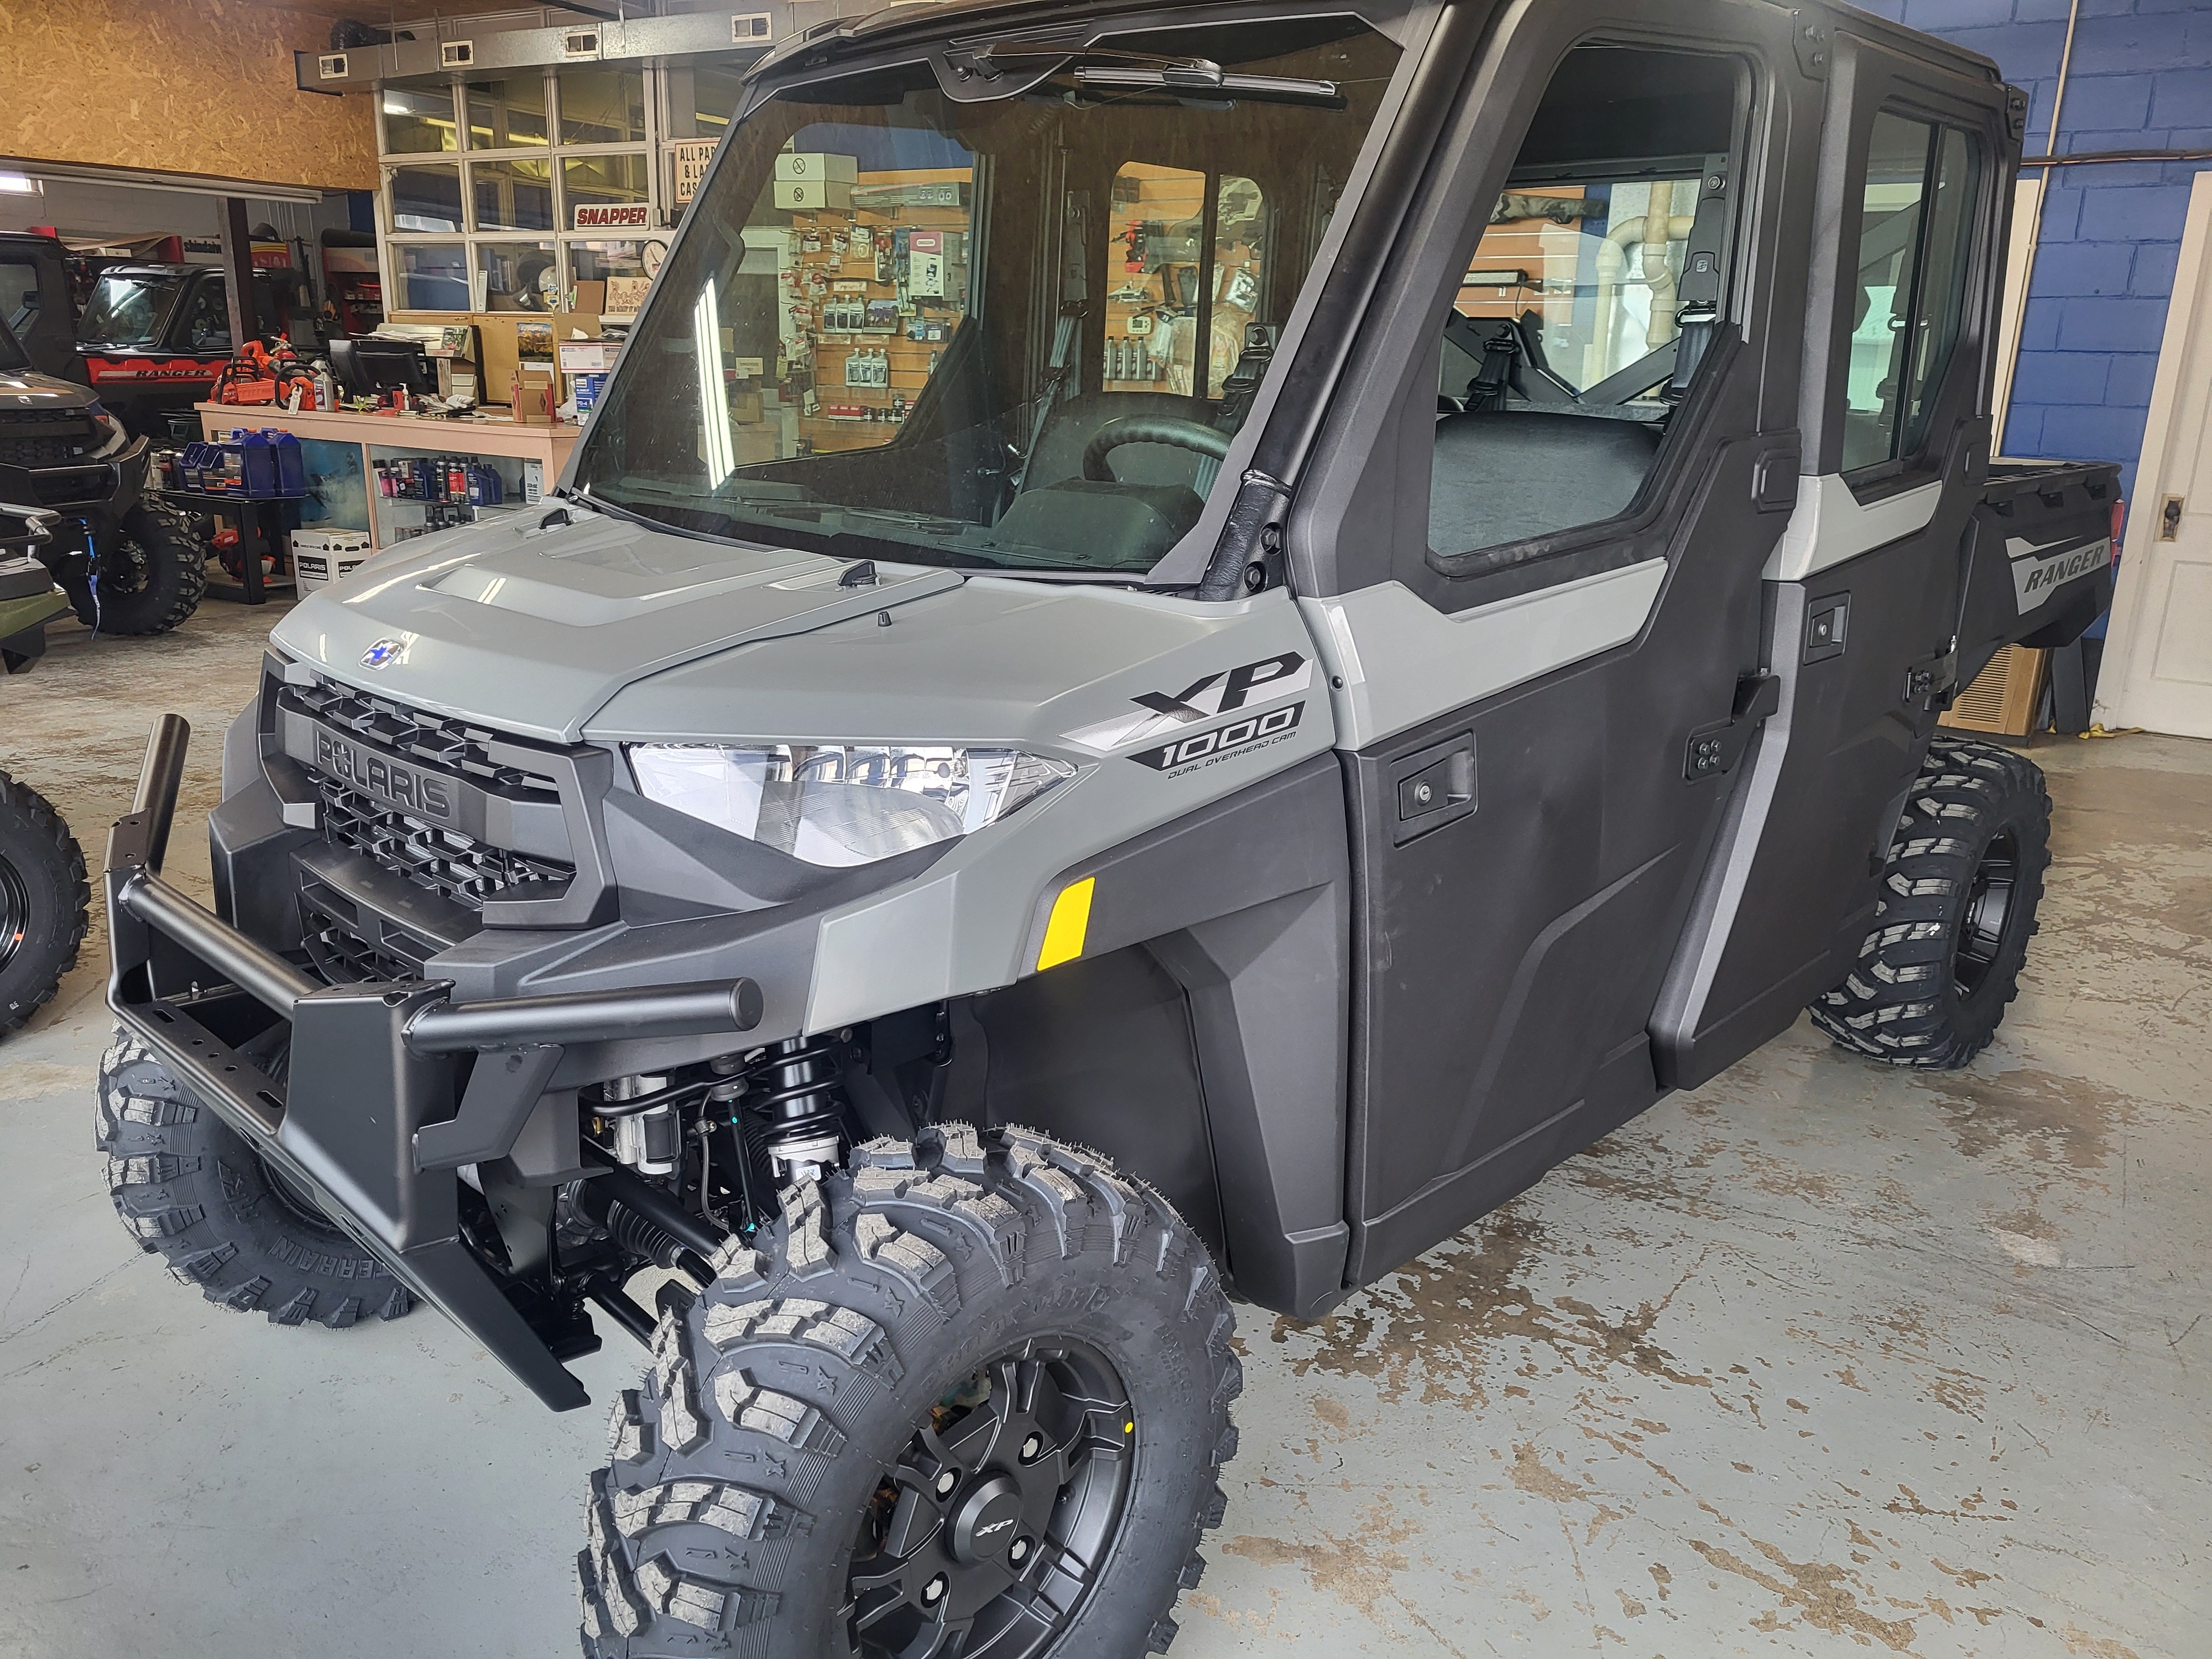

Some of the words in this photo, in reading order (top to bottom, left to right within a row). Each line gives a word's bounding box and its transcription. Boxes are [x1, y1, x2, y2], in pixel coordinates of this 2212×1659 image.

[680, 147, 696, 162] ALL
[685, 164, 691, 179] &
[693, 164, 709, 179] LA
[577, 207, 647, 225] SNAPPER
[299, 561, 326, 571] POLARIS
[2023, 544, 2105, 593] RANGER
[1128, 650, 1306, 724] XP
[1161, 706, 1296, 769] 1000
[1167, 763, 1202, 780] DUAL
[1206, 740, 1269, 767] OVERHEAD
[1271, 731, 1296, 745] CAM
[316, 729, 451, 820] POLARIS
[975, 1519, 1014, 1537] XP
